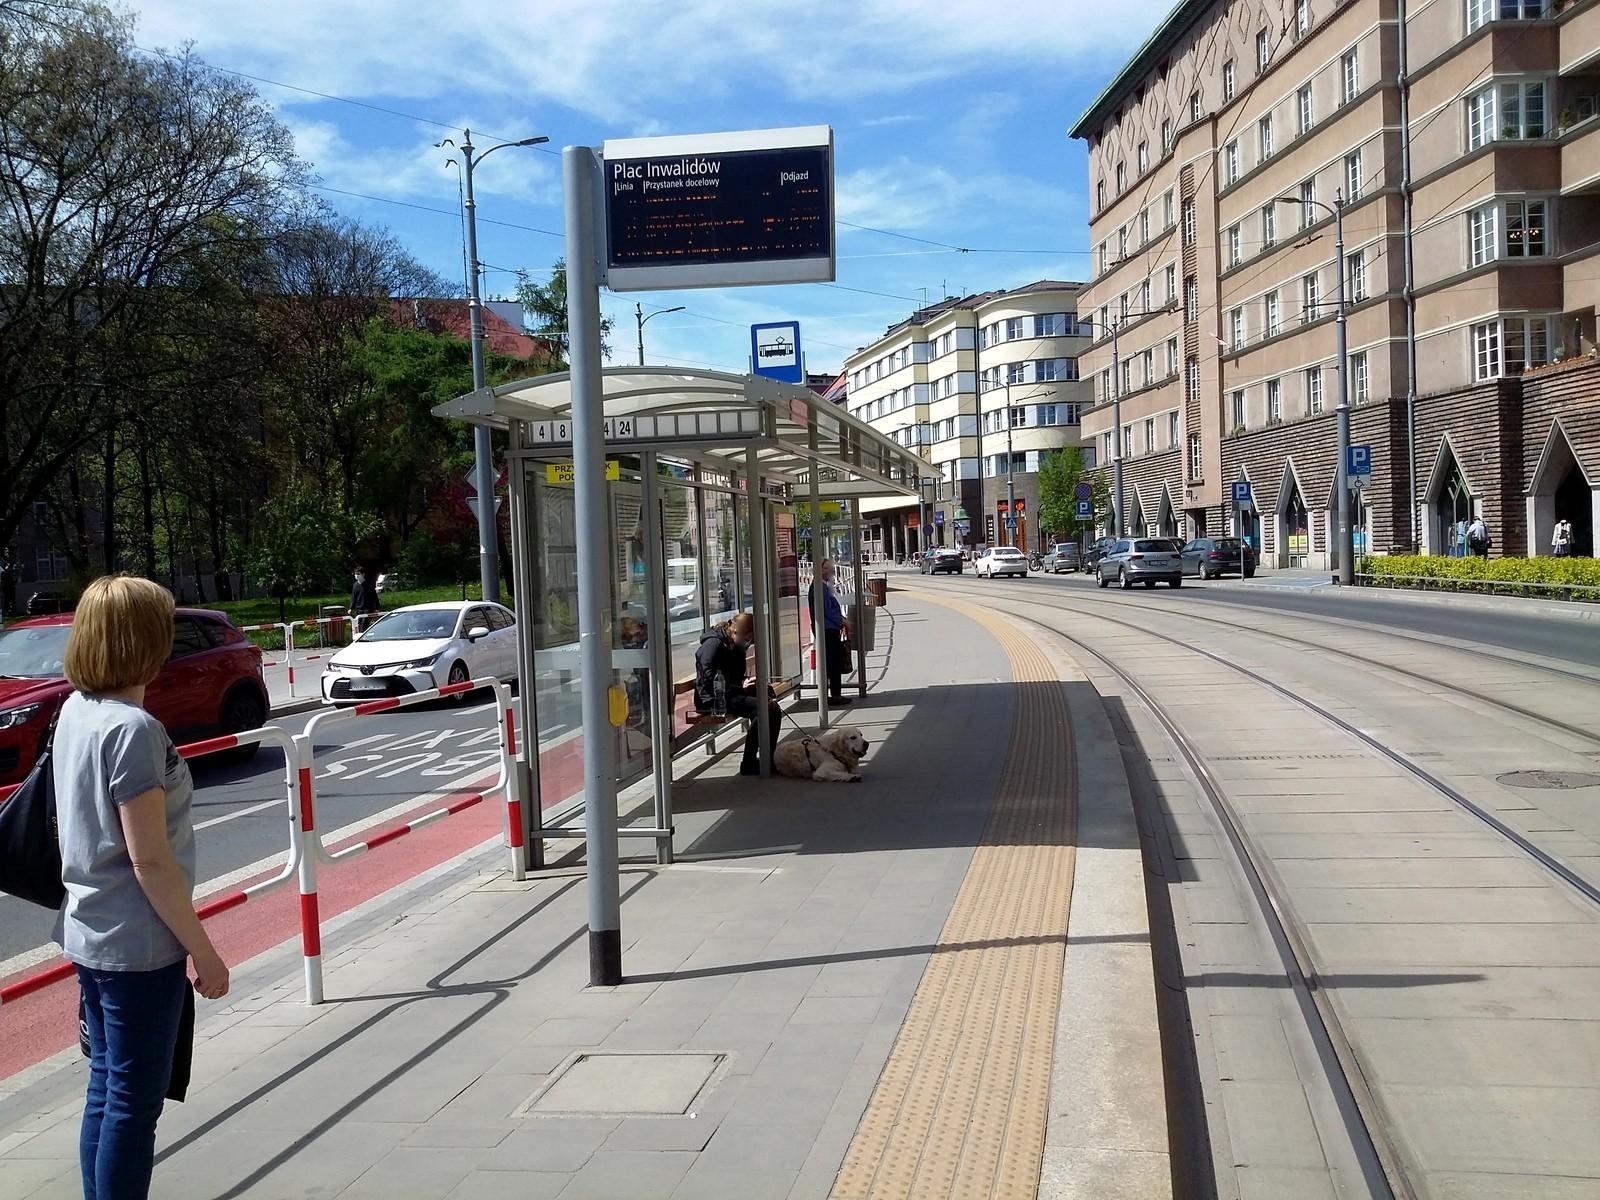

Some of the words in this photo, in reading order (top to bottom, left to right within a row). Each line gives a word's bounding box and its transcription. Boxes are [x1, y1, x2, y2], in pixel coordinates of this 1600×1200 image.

[614, 162, 643, 179] Plac
[647, 158, 720, 177] Inwalidów
[783, 170, 809, 182] Odjazd
[616, 182, 634, 191] Linia
[645, 179, 684, 191] Przystanek
[685, 178, 720, 187] docelowy
[539, 425, 545, 439] 4
[560, 424, 566, 438] 8
[619, 421, 631, 435] 24
[1353, 448, 1366, 467] P
[1236, 484, 1247, 499] P
[1080, 502, 1088, 512] P
